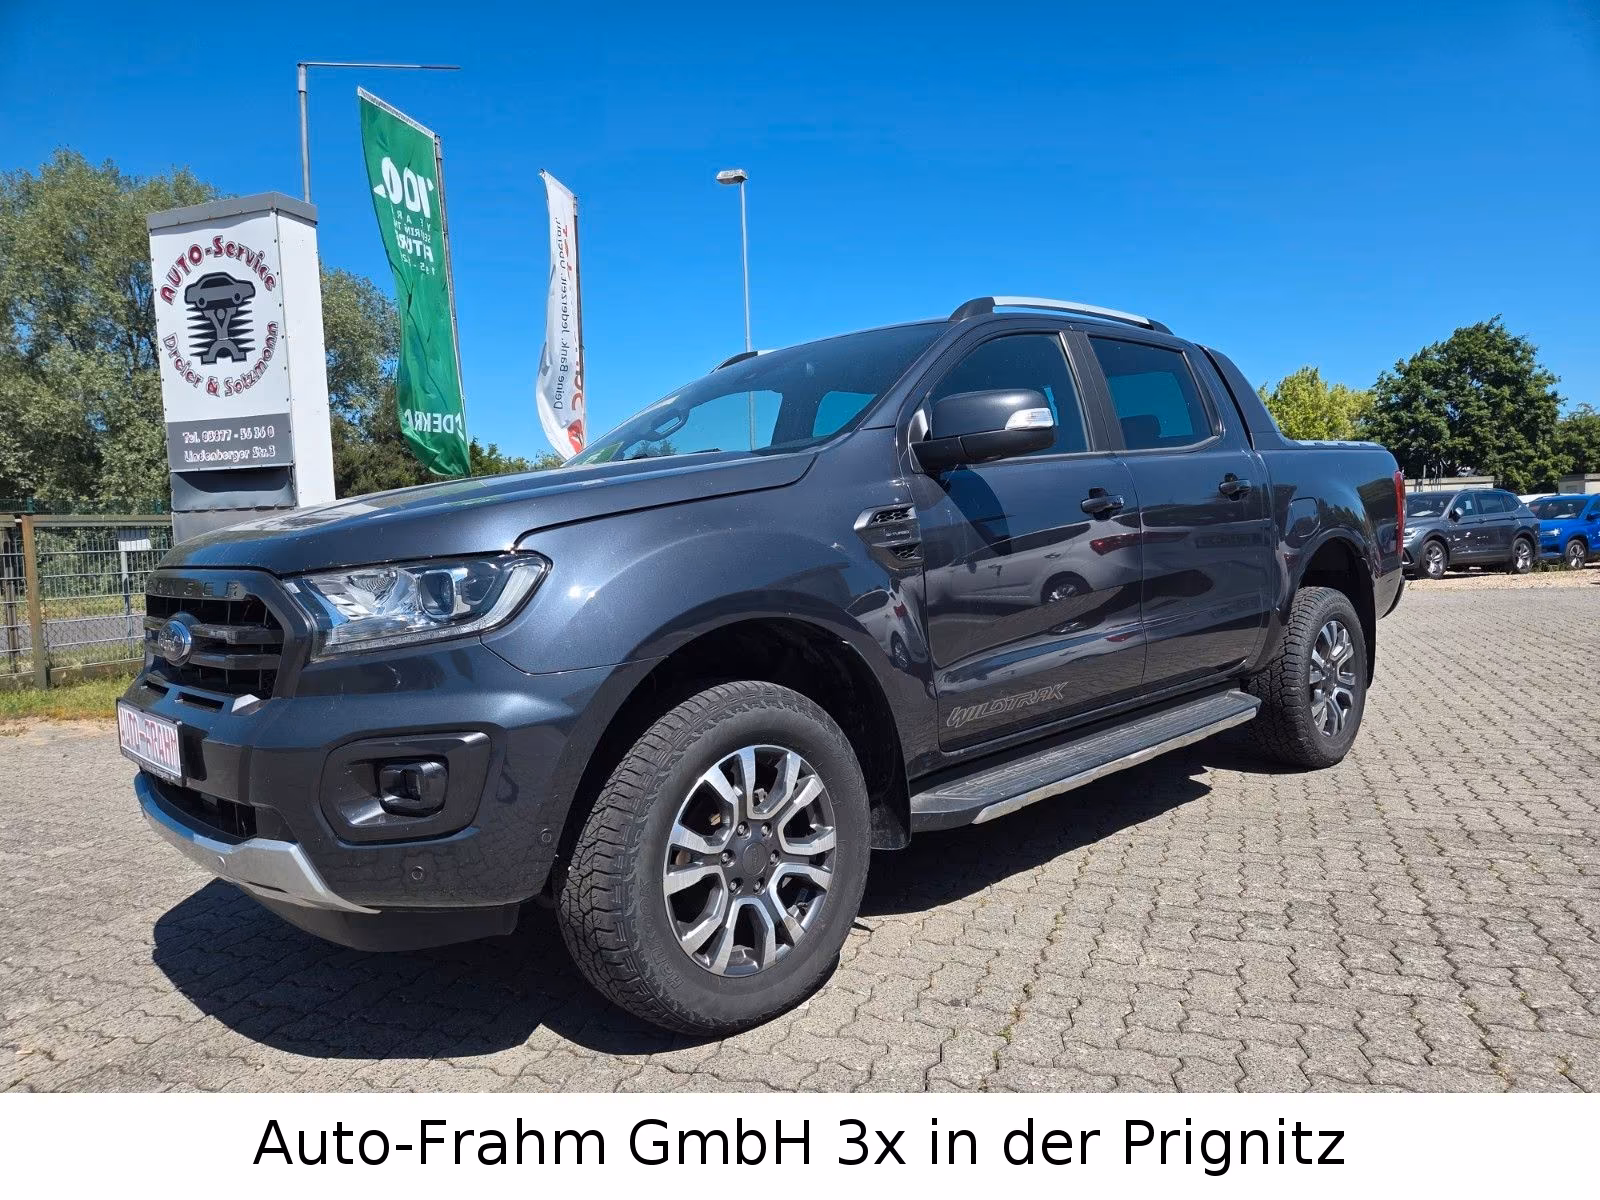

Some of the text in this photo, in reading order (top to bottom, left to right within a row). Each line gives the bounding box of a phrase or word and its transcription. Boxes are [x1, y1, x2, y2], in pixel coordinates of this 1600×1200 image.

[163, 333, 204, 388] Dreier
[206, 376, 220, 397] &
[182, 431, 200, 444] Tel.
[184, 449, 250, 463] Lindenberger
[946, 681, 1069, 728] WILDTRAK
